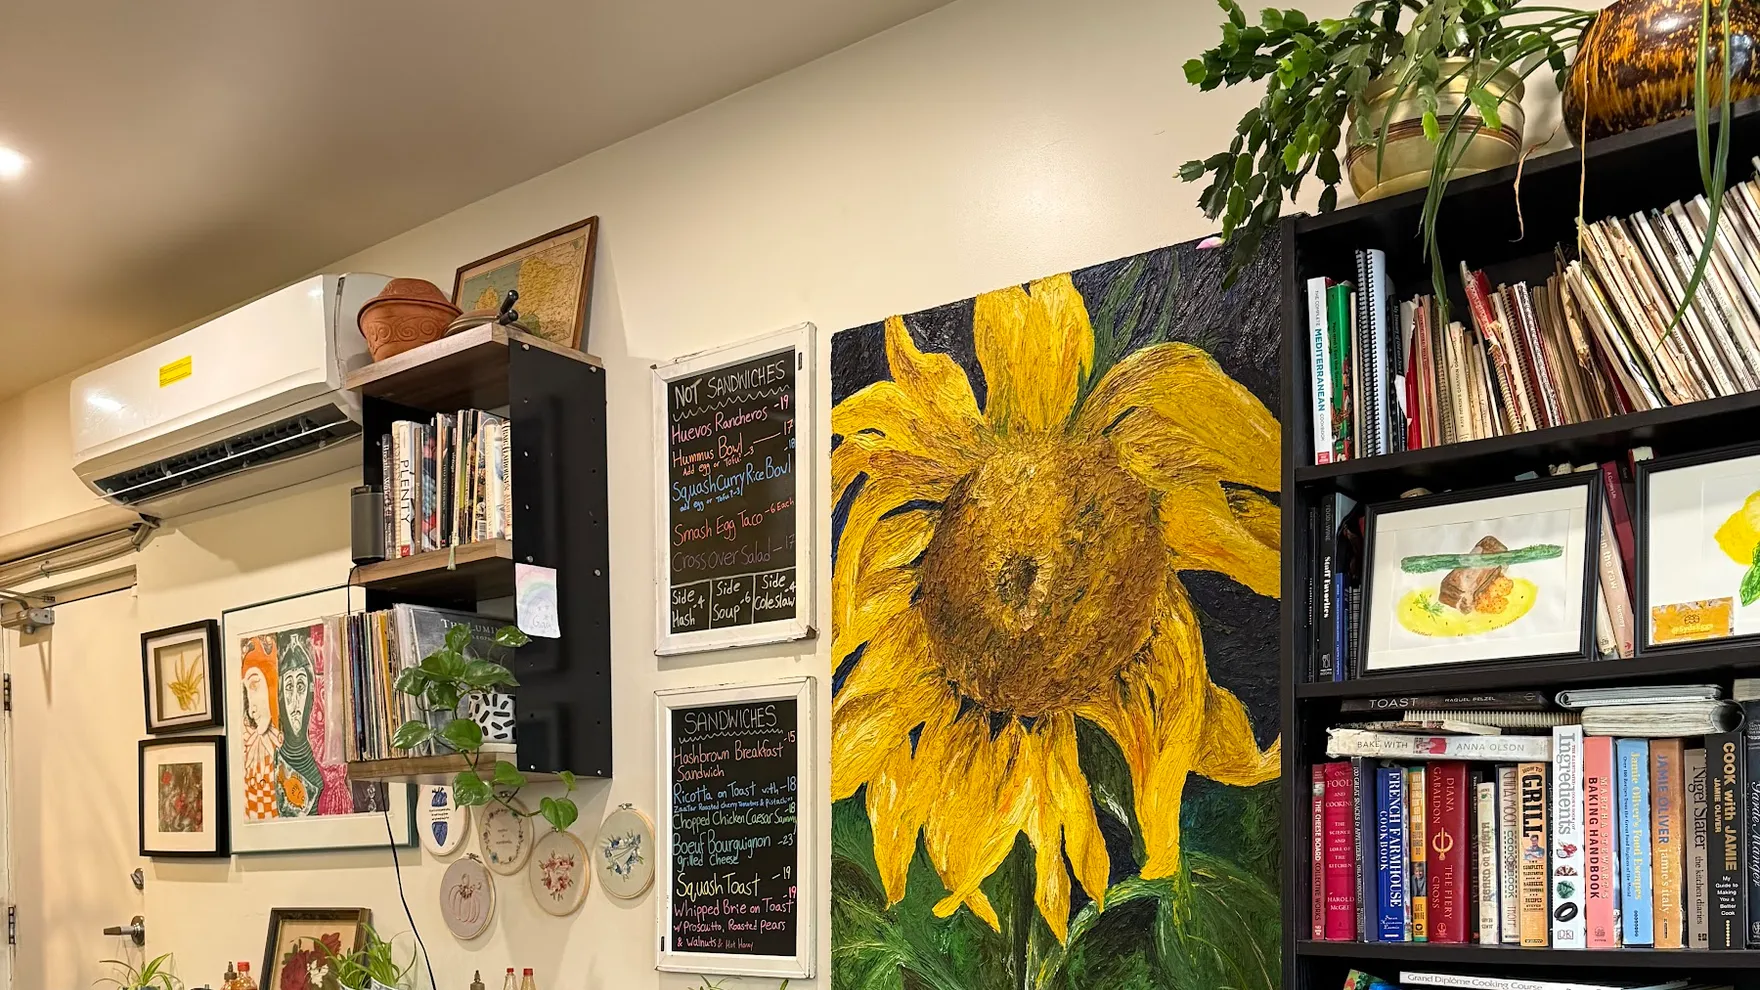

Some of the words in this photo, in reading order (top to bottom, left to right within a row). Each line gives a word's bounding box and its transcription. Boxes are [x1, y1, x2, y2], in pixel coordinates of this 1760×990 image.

[674, 378, 702, 409] NOT
[707, 360, 785, 399] SANDWICHES
[1315, 329, 1325, 412] MEDITERRANEAN
[672, 423, 713, 445] Huevos
[715, 406, 768, 432] Rancheros
[673, 449, 714, 468] Hummus
[718, 432, 743, 459] Bowl
[673, 475, 716, 504] Squash
[717, 472, 744, 496] Curry
[746, 463, 765, 485] Rice
[766, 454, 791, 479] Bowl
[699, 463, 711, 477] egg
[400, 459, 410, 524] PLENTY
[693, 501, 704, 511] egg
[673, 519, 712, 546] Smash
[716, 515, 736, 541] Egg
[738, 510, 763, 528] Taco
[777, 497, 794, 511] Each
[741, 536, 771, 565] Salad
[717, 579, 740, 596] Side
[762, 573, 786, 589] Side
[1602, 552, 1612, 568] the
[1607, 570, 1618, 589] raw
[1617, 604, 1626, 628] Kenney
[672, 589, 695, 605] Side
[672, 608, 695, 628] Hash
[713, 603, 740, 622] Soup
[1369, 698, 1419, 708] TOAST
[684, 704, 778, 735] SANDWICHES
[674, 744, 730, 767] Hashbrown
[735, 739, 783, 761] Breakfast
[1384, 741, 1408, 749] WITH
[1489, 743, 1525, 752] OLSON
[676, 765, 725, 782] Sandwich
[1631, 752, 1641, 784] Jamie
[1657, 755, 1669, 792] JAMIE
[1723, 742, 1736, 784] COOK
[673, 783, 712, 804] Ricotta
[727, 781, 756, 797] Toast
[762, 782, 778, 795] with
[1327, 778, 1353, 788] FOOD
[1389, 772, 1400, 824] FRENCH
[1433, 767, 1441, 825] GABALDON
[1446, 778, 1454, 813] DIANA
[1556, 733, 1575, 835] Ingredients
[1687, 766, 1706, 804] Nigel
[1522, 774, 1543, 838] GRILL
[1588, 777, 1598, 825] BAKING
[1600, 777, 1608, 828] MARTHA
[1632, 787, 1642, 827] Oliver's
[1723, 790, 1736, 821] with
[672, 812, 710, 835] Chopped
[712, 810, 745, 826] Chicken
[746, 808, 773, 826] Caesar
[1658, 796, 1670, 844] OLIVER
[1694, 806, 1707, 850] Slater
[1714, 803, 1722, 833] OLIVER
[672, 832, 707, 856] Boeuf
[708, 829, 771, 859] Bourguignon
[1380, 810, 1388, 871] COOKBOOK
[1633, 830, 1642, 855] Food
[1724, 824, 1737, 871] JAMIE
[709, 854, 739, 866] Cheese
[1389, 828, 1402, 908] FARMHOUSE
[1444, 865, 1452, 885] THE
[1589, 830, 1600, 899] HANDBOOK
[1601, 832, 1610, 899] STEWART'S
[1658, 848, 1672, 886] jamie's
[1696, 856, 1704, 868] the
[676, 873, 724, 902] Squash
[722, 872, 761, 897] Toast
[1633, 858, 1643, 900] Escapes
[1696, 869, 1705, 898] kitchen
[674, 899, 720, 922] Whipped
[723, 899, 747, 915] Brie
[750, 905, 760, 913] on
[762, 897, 794, 913] Toast
[1660, 889, 1673, 914] italy
[1697, 900, 1705, 925] diaries
[728, 919, 757, 931] Roasted
[1557, 930, 1574, 940] DK
[677, 937, 683, 947] &
[1408, 974, 1433, 982] Grand
[1435, 975, 1470, 987] Diplôme
[1472, 978, 1509, 990] Cooking
[1511, 982, 1543, 990] Course
